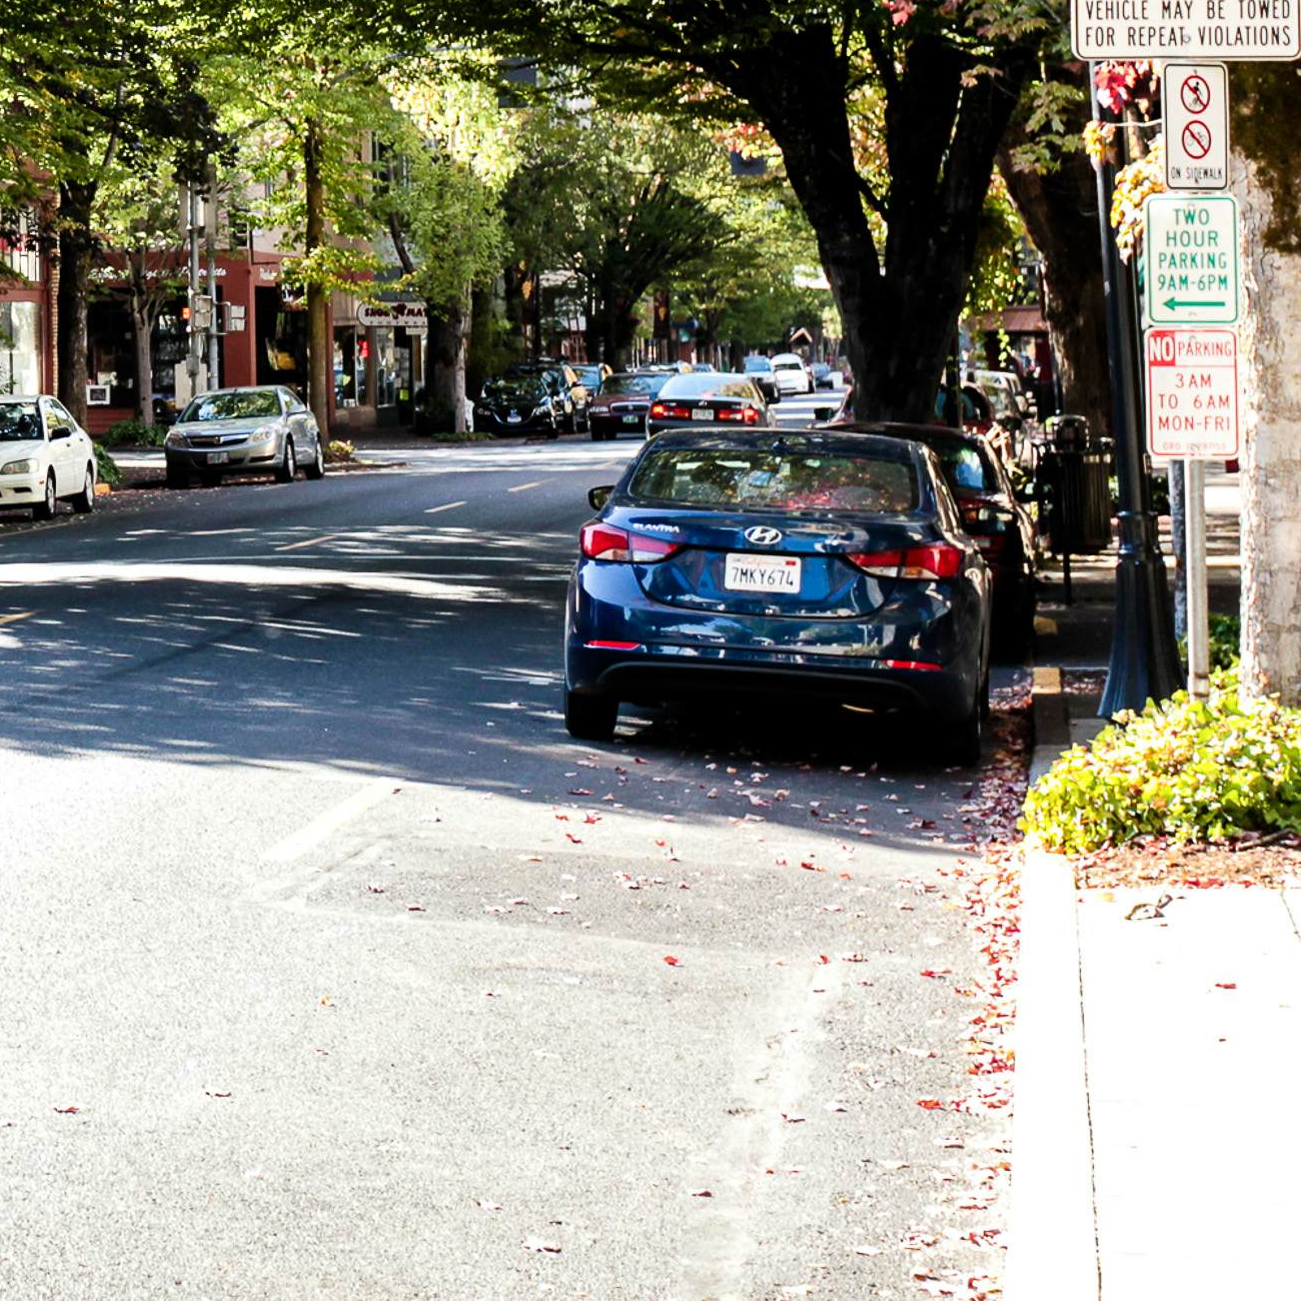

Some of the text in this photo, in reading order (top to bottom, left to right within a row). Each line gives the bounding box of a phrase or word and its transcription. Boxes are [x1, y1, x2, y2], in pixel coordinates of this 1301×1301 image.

[1085, 0, 1291, 20] VEHICLE MAY BE TOWED
[1085, 25, 1291, 46] FOR REPEAT VIOLATIONS
[1170, 166, 1223, 180] ON SIDEWALK
[1174, 208, 1210, 225] TWO
[1166, 231, 1219, 247] HOUR
[1158, 252, 1228, 269] PARKING
[1158, 274, 1228, 291] 9AM-6PM
[1149, 336, 1233, 362] NO PARKING
[1158, 393, 1179, 409] TO
[1158, 415, 1231, 431] MON-FRI
[731, 566, 794, 587] 7MKY674
